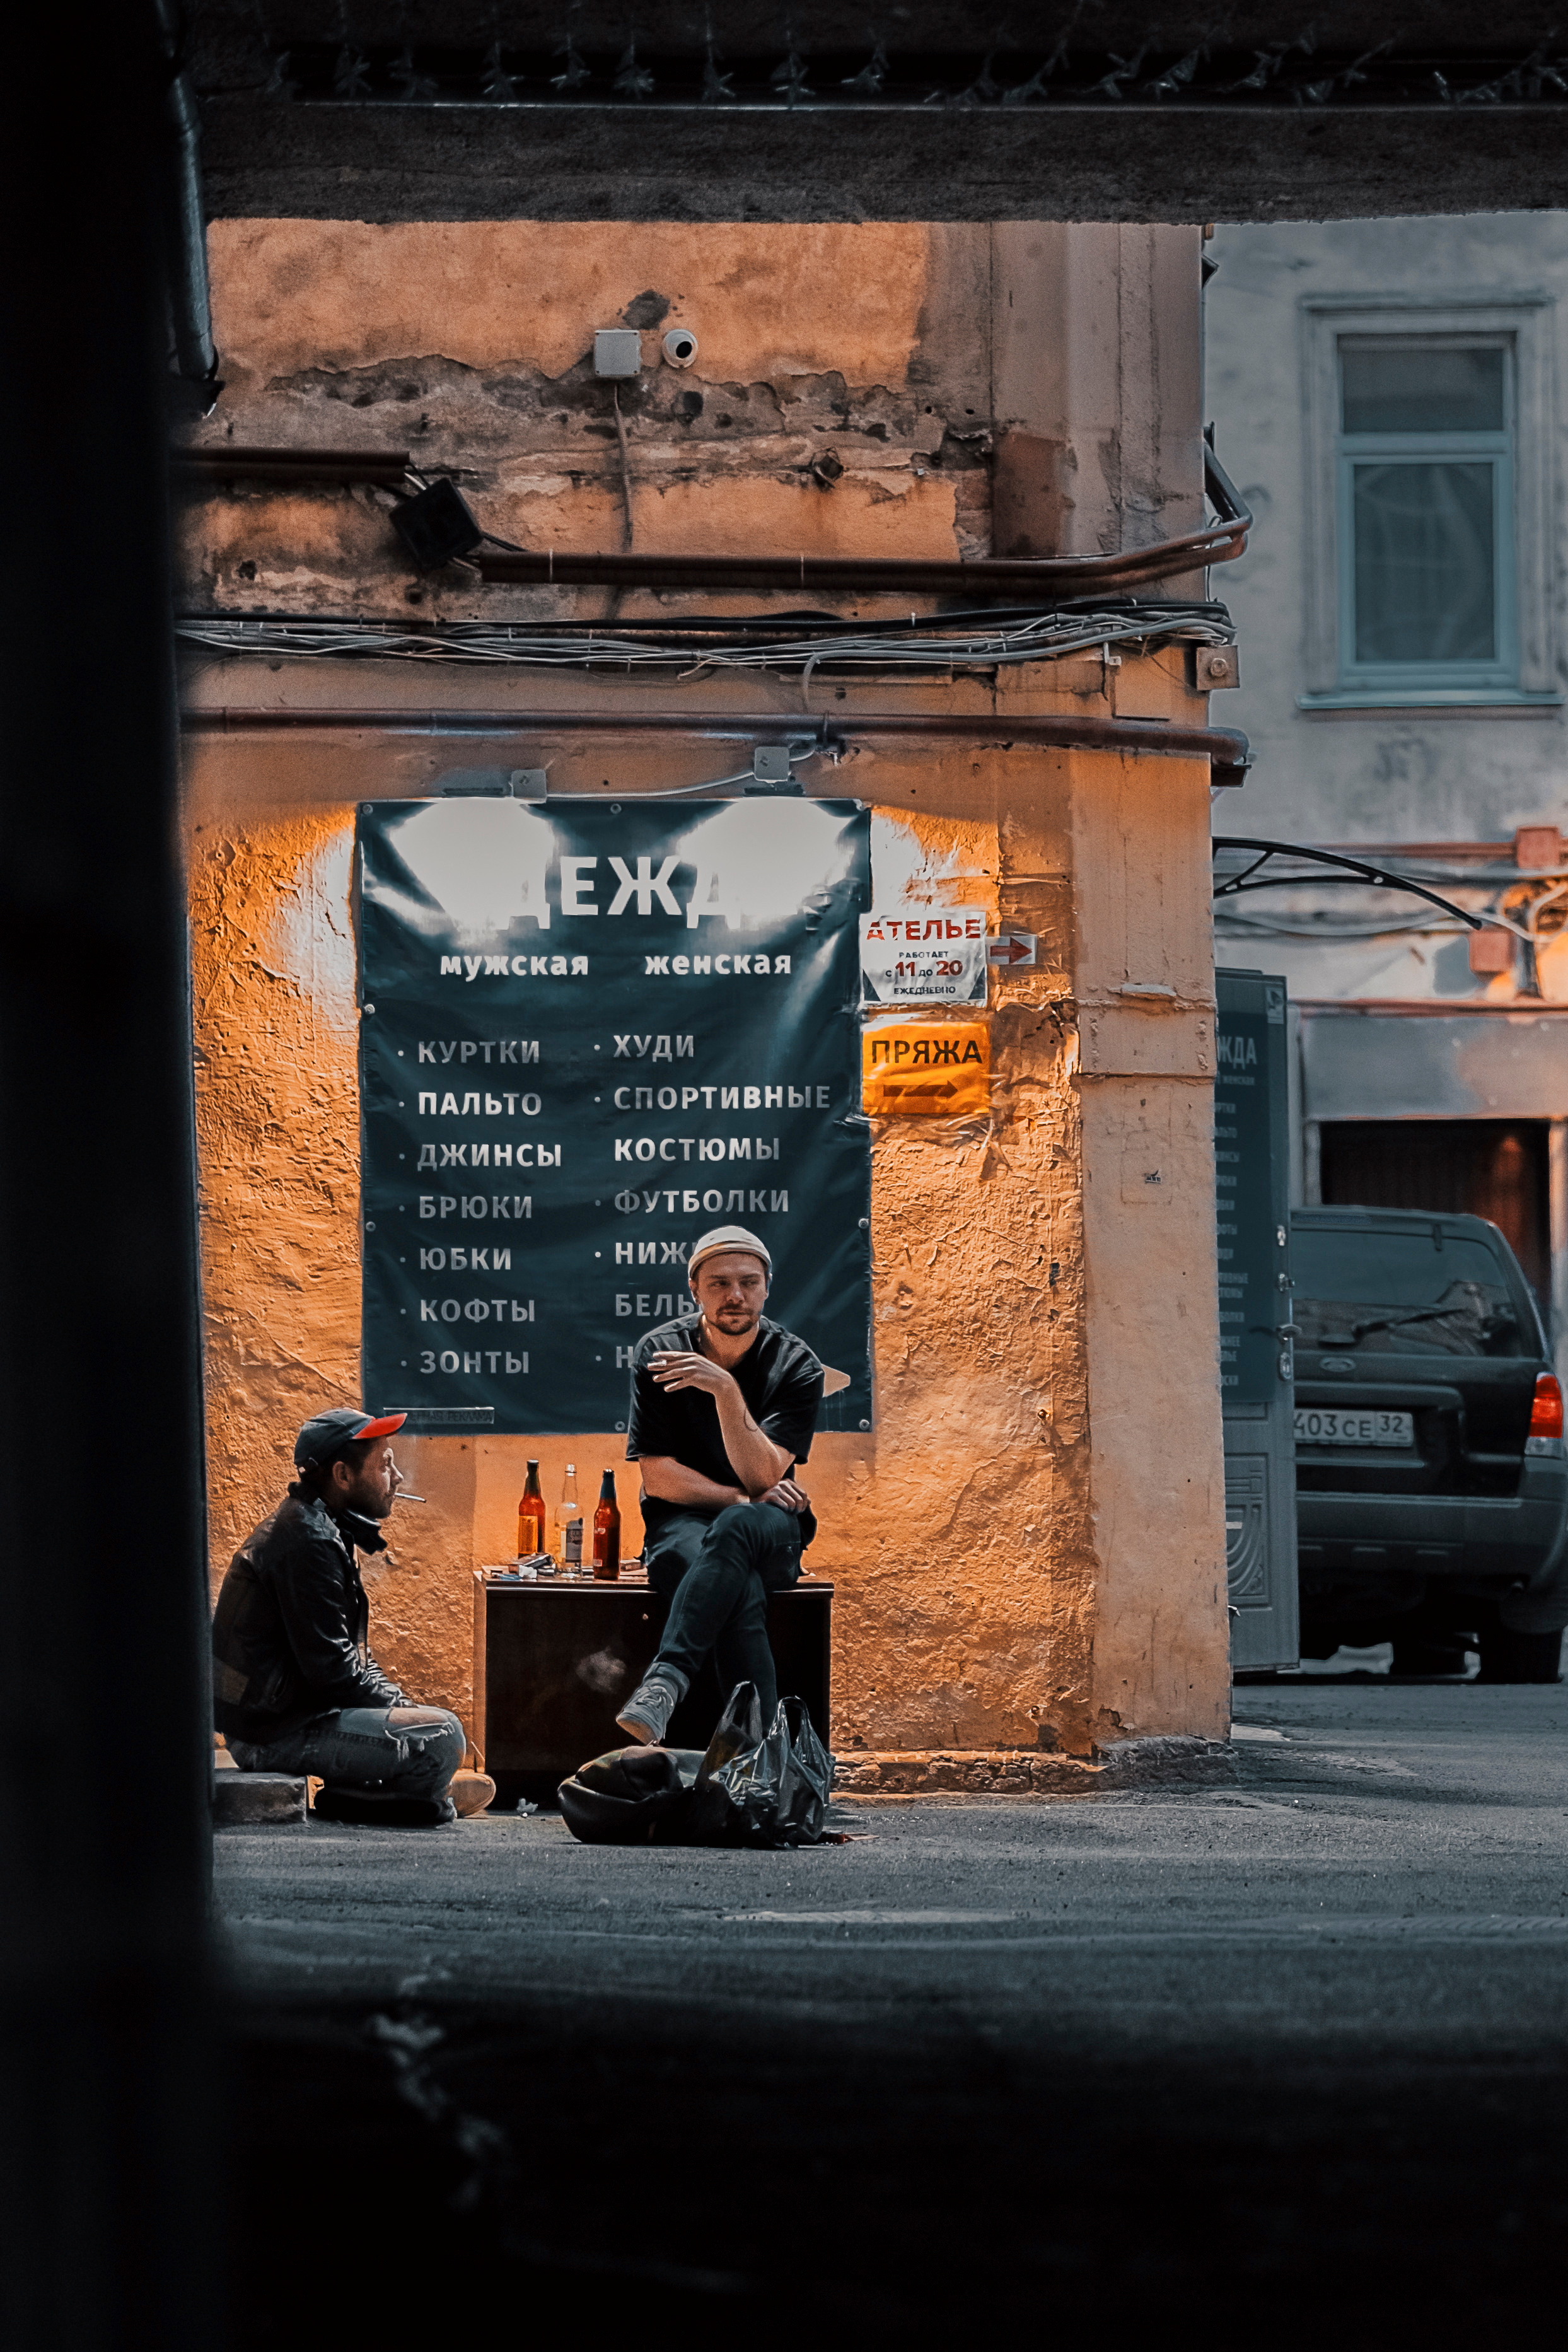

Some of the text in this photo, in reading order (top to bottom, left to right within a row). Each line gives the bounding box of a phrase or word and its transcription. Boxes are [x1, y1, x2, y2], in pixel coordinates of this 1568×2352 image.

[866, 919, 981, 941] АТЕЛЬЕ
[440, 953, 791, 981] мужская женская
[898, 951, 949, 959] РАБОТАЕТ
[895, 961, 915, 977] 11
[936, 960, 963, 976] 20
[894, 986, 956, 995] ЕЖЕДНЕВНО
[418, 1040, 540, 1064] КУРТКИ
[613, 1035, 694, 1062] ХУДИ
[872, 1040, 983, 1064] ПРЯЖА
[1216, 1035, 1257, 1069] ЖДА
[419, 1092, 542, 1115] ПАЛЬТО
[613, 1085, 831, 1110] СПОРТИВНЫЕ
[417, 1143, 562, 1171] ДЖИНСЫ
[614, 1137, 780, 1161] КОСТЮМЫ
[419, 1196, 533, 1219] БРЮКИ
[614, 1189, 789, 1213] ФУТБОЛКИ
[420, 1247, 512, 1270] ЮБКИ
[615, 1242, 697, 1264] НИЖ
[421, 1298, 535, 1323] КОФТЫ
[615, 1294, 694, 1317] БЕЛЬ
[420, 1350, 530, 1373] ЗОНТЫ
[1294, 1412, 1403, 1438] 403СЕ 32
